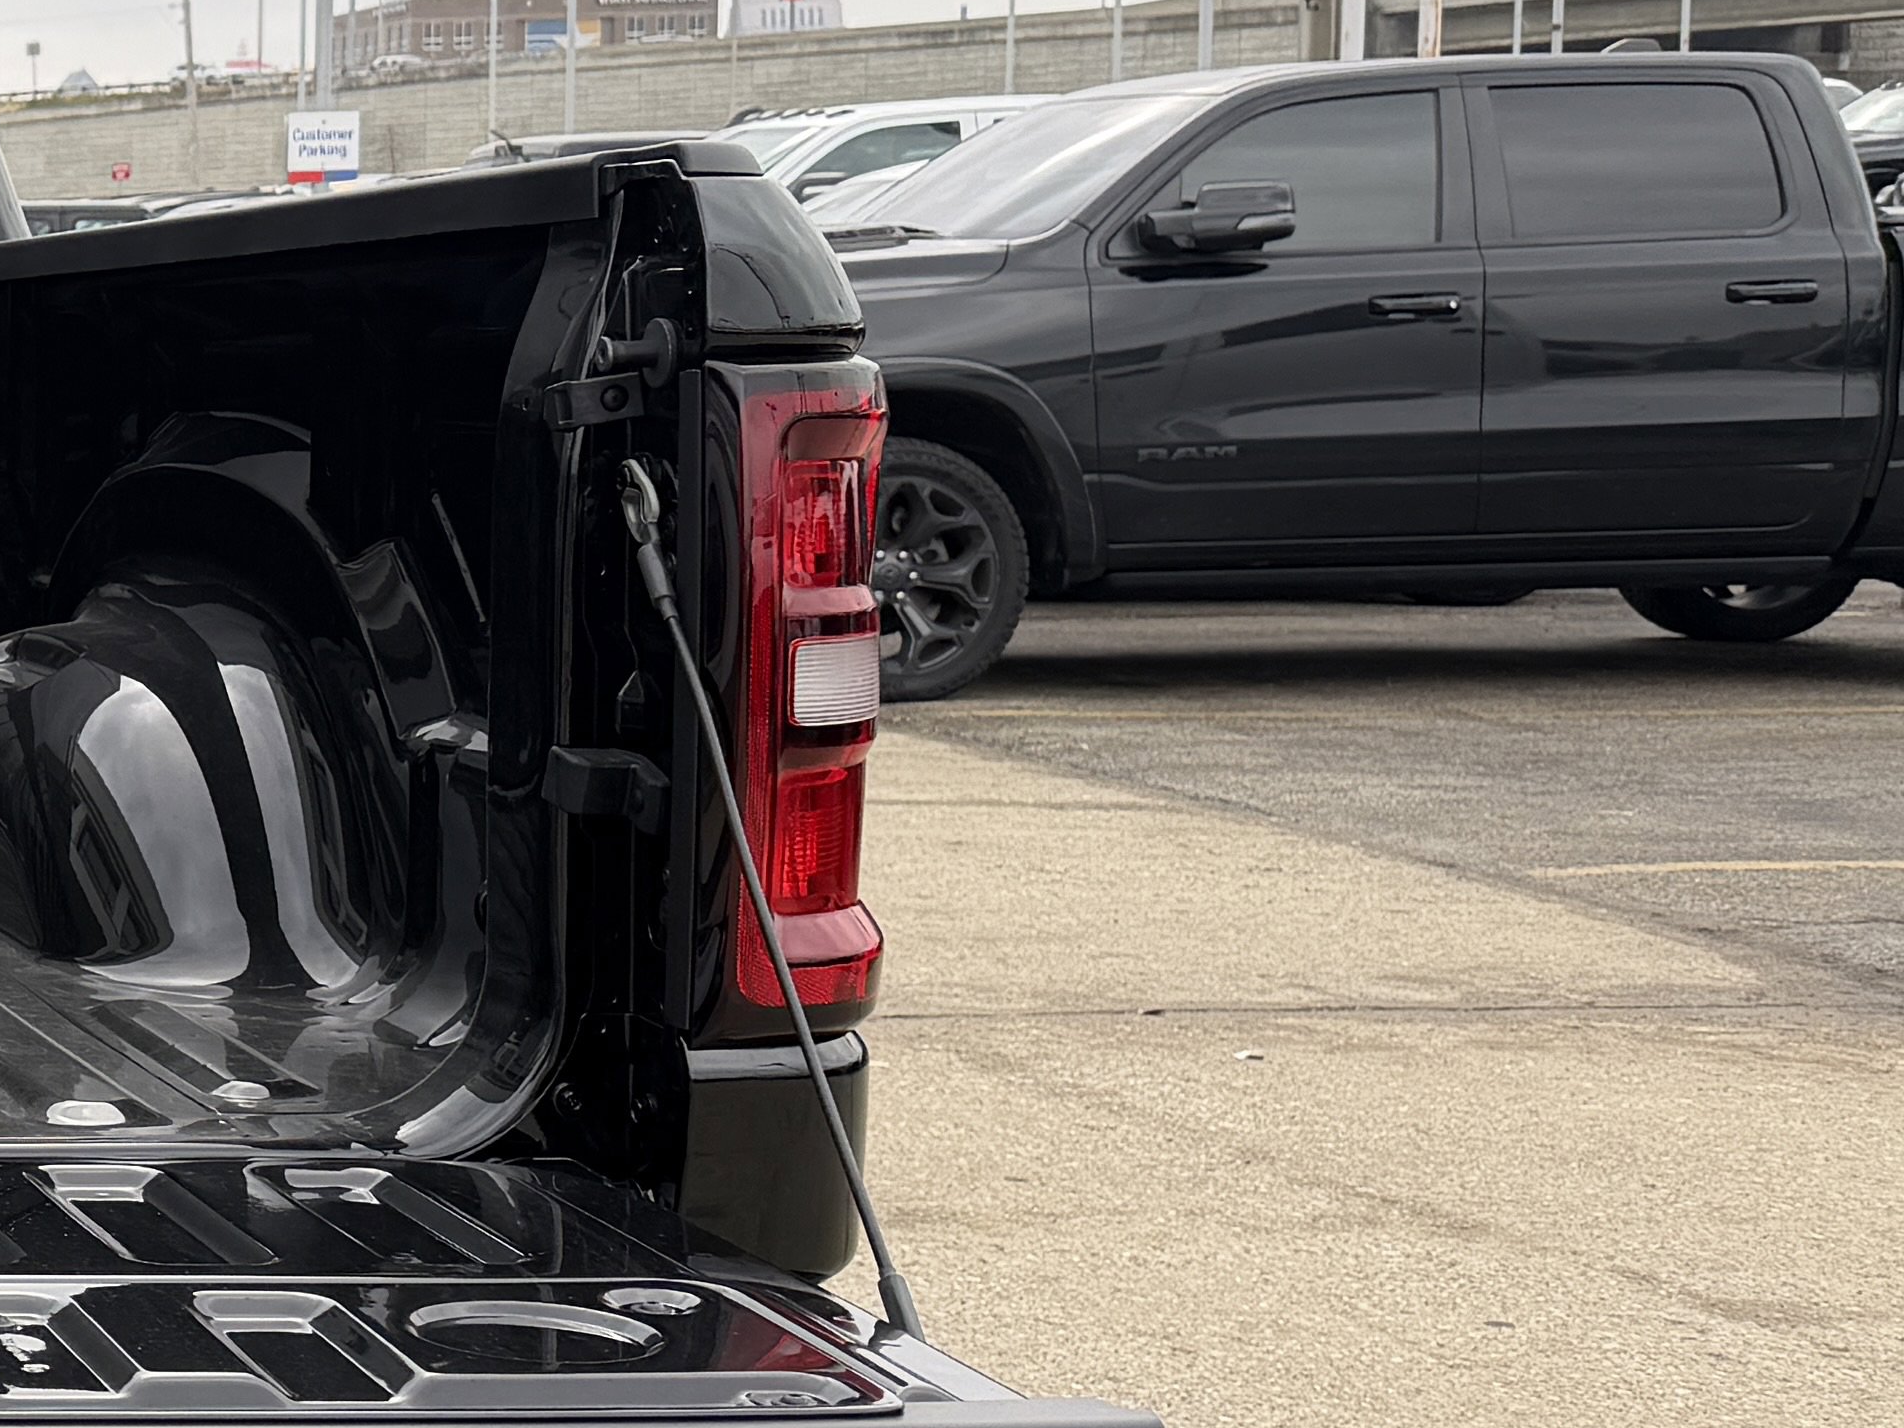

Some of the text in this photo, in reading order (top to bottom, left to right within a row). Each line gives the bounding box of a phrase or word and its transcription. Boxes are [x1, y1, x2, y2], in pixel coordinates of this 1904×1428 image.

[292, 128, 353, 142] Customer
[298, 144, 347, 158] Parking
[1137, 446, 1238, 463] RAM
